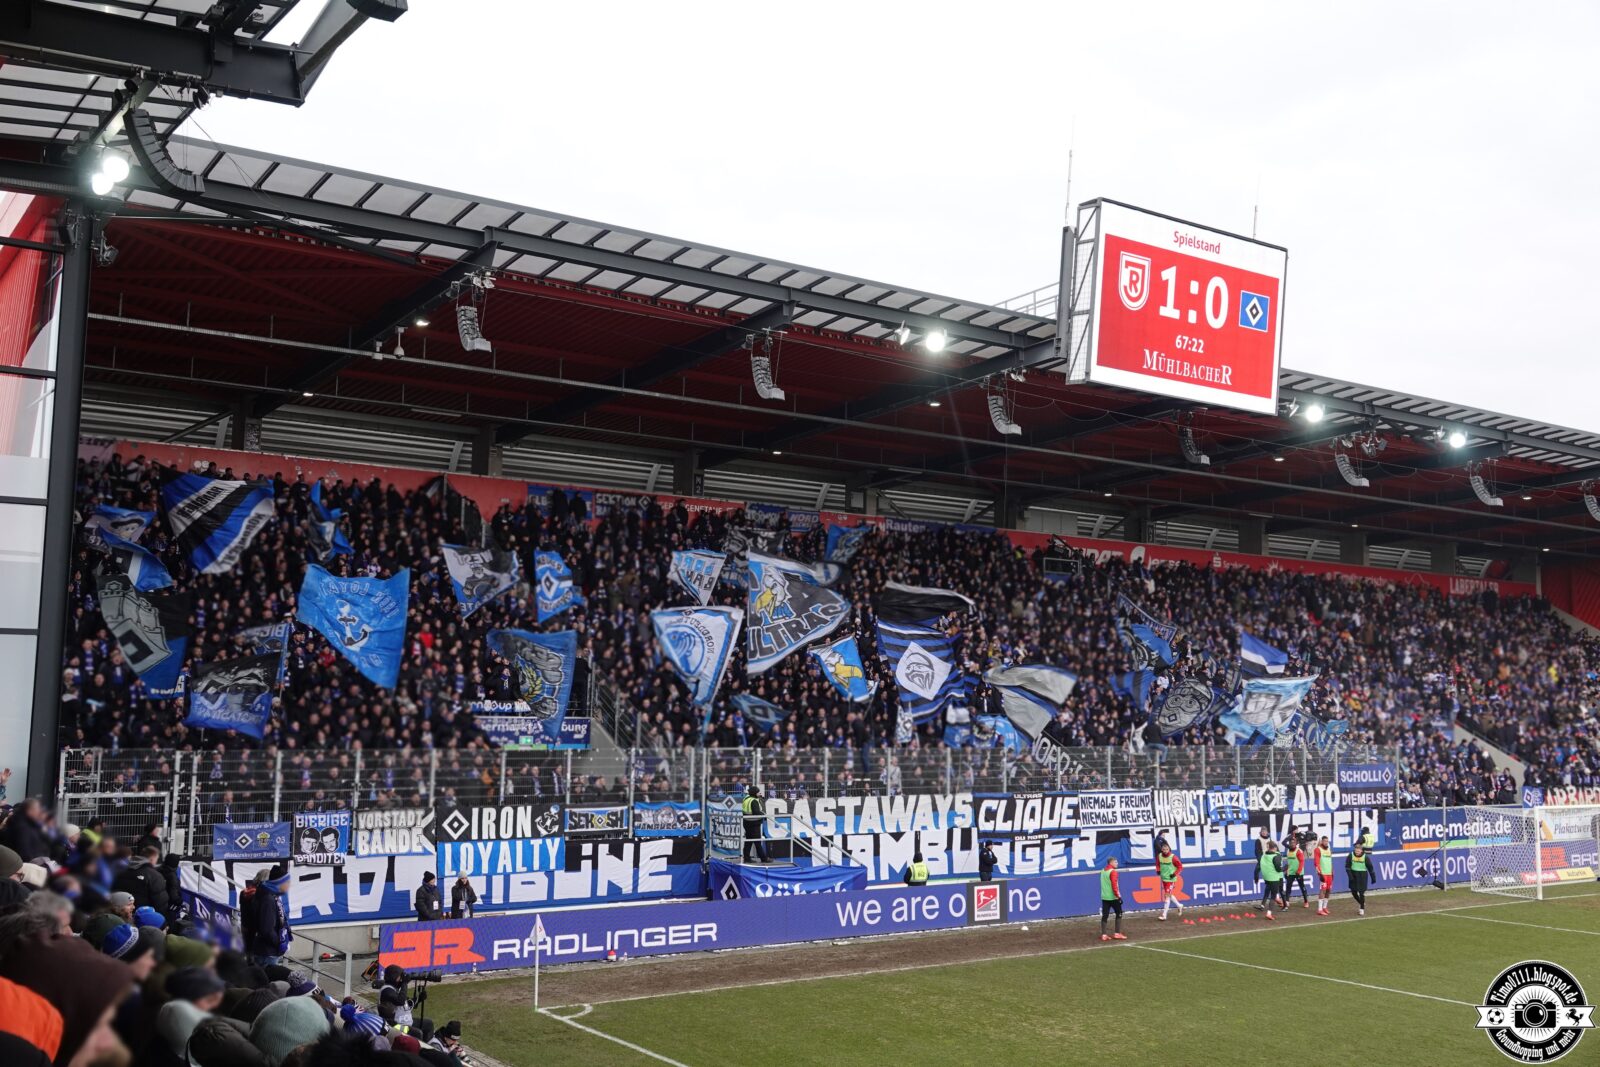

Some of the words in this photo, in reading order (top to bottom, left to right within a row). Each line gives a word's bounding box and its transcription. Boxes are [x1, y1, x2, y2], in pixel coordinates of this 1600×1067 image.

[1173, 230, 1221, 255] Spielstand
[1159, 265, 1229, 329] 1:0
[1175, 334, 1205, 354] 67:22
[1142, 348, 1233, 386] MÜHLBACHER
[1340, 770, 1382, 783] SCHOLLI
[1080, 795, 1116, 810] NIEMALS
[1119, 794, 1151, 809] FREUND
[1293, 783, 1341, 812] ALTO
[1341, 792, 1394, 806] DIEMELSEE
[357, 808, 425, 829] VORSTADT
[471, 805, 532, 840] IRON
[765, 793, 974, 842] CASTAWAYS
[979, 796, 1079, 834] CLIQUE
[1081, 811, 1118, 826] NIEMALS
[1121, 809, 1153, 824] HELFER
[1402, 815, 1511, 841] andre-media.de
[357, 828, 425, 856] BANDE
[295, 851, 348, 865] BANDITEN
[444, 837, 561, 877] LOYALTY
[1379, 860, 1407, 881] we
[1412, 857, 1441, 880] are
[1446, 854, 1478, 876] one
[835, 898, 882, 927] we
[892, 894, 940, 923] are
